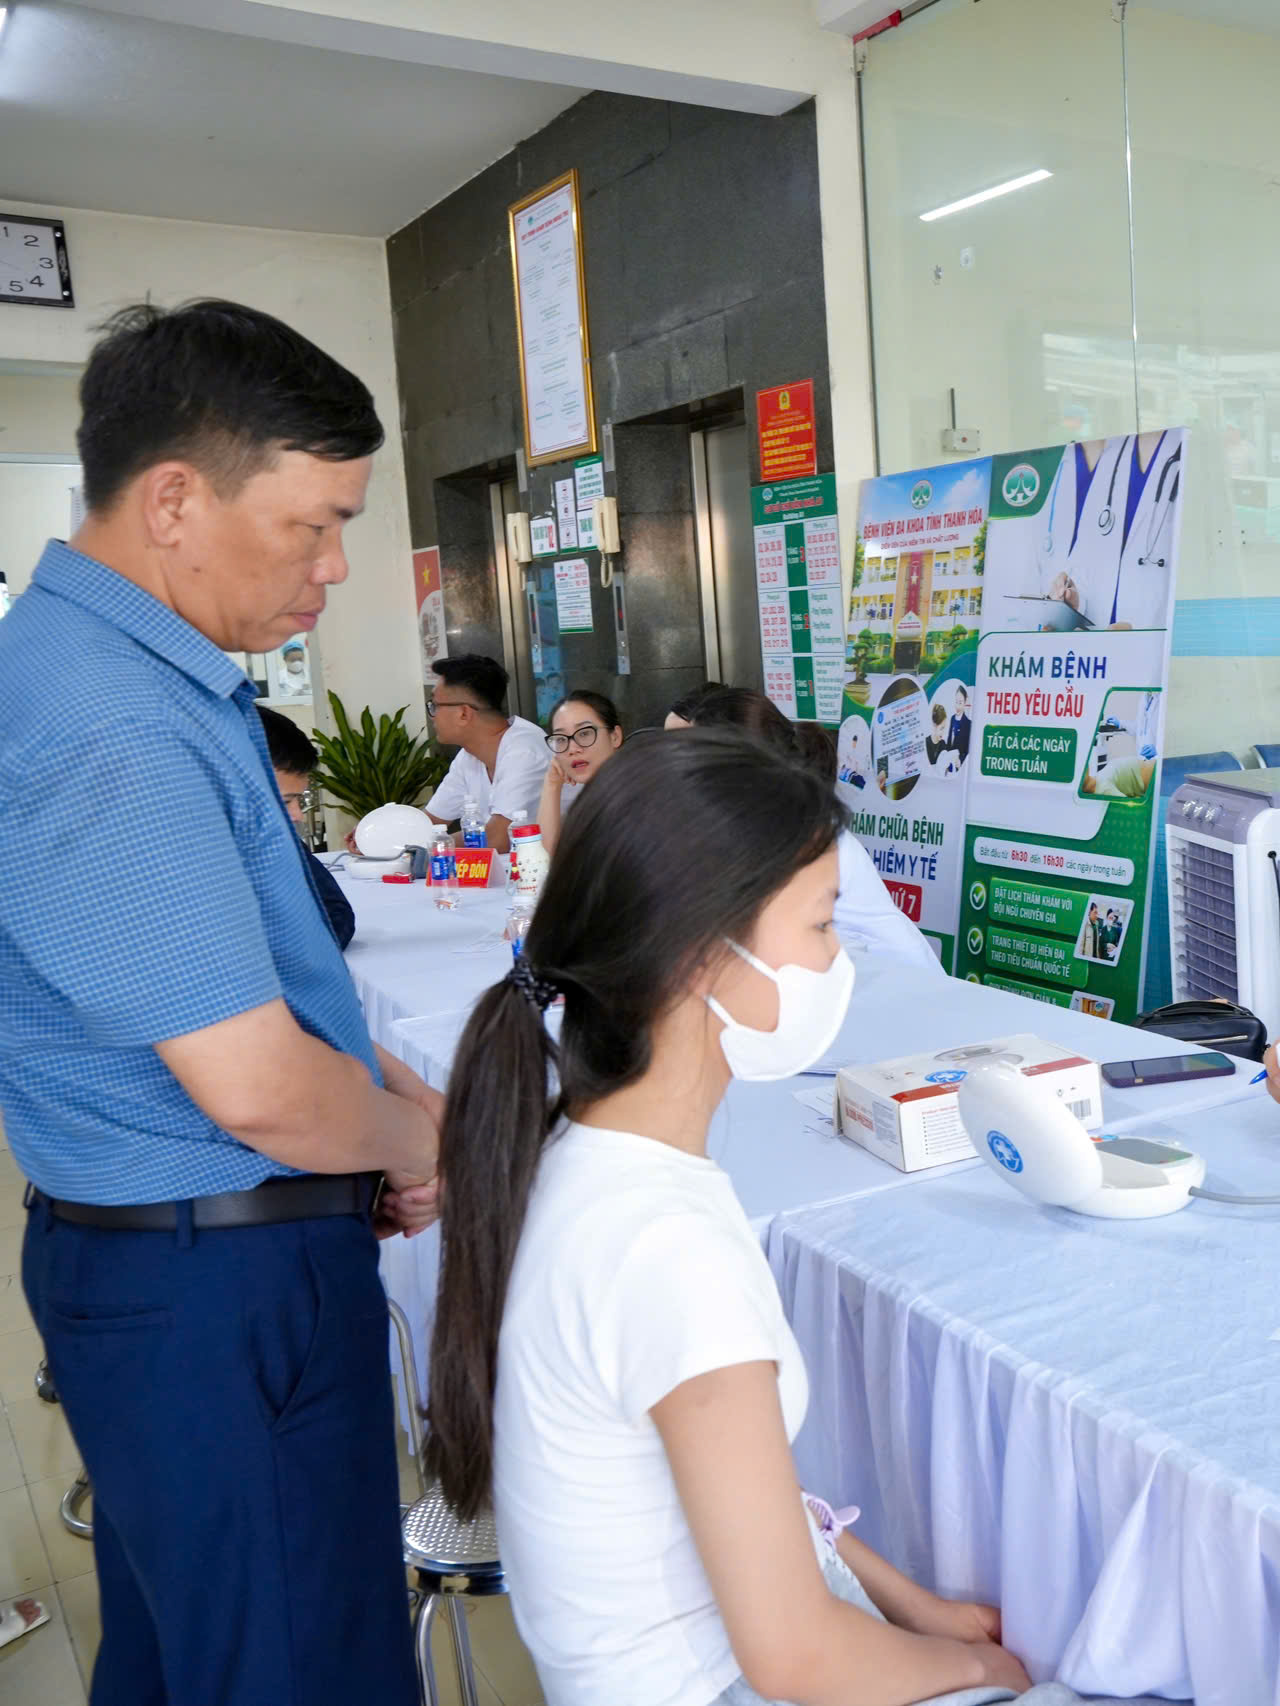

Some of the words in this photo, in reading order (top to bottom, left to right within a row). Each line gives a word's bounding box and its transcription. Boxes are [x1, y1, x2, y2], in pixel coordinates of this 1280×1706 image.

[3, 226, 9, 237] 1
[23, 234, 40, 247] 2
[39, 257, 54, 269] 3
[9, 280, 24, 292] 5
[30, 275, 44, 287] 4
[863, 522, 879, 539] BỆNH
[881, 520, 895, 539] VIỆN
[896, 520, 905, 535] ĐA
[907, 517, 924, 533] KHOA
[926, 512, 942, 530] TỈNH
[943, 511, 967, 528] THANH
[988, 650, 1044, 678] KHÁM
[1051, 650, 1107, 684] BỆNH
[987, 691, 1021, 715] THEO
[1025, 687, 1051, 716] YÊU
[1054, 685, 1084, 718] CẦU
[987, 731, 1004, 748] TẤT
[1005, 732, 1019, 750] CẢ
[1020, 734, 1041, 752] CÁC
[1043, 735, 1071, 753] NGÀY
[985, 756, 1019, 772] TRONG
[1021, 755, 1048, 774] TUẦN
[851, 808, 876, 836] HÁM
[879, 812, 909, 841] CHỮA
[912, 816, 944, 849] BỆNH
[469, 859, 488, 878] ĐÓN
[873, 844, 906, 875] HIỂM
[909, 855, 918, 877] Y
[920, 851, 938, 880] TẾ
[980, 846, 989, 856] Bắt
[1011, 850, 1028, 862] 6h30
[1030, 854, 1041, 864] đến
[1043, 855, 1064, 868] 16h30
[1066, 860, 1077, 870] các
[1077, 861, 1092, 873] ngày
[1093, 864, 1110, 877] trong
[1111, 865, 1126, 877] tuần
[908, 894, 917, 914] 7
[994, 887, 1007, 901] ĐẶT
[1008, 889, 1022, 903] LỊCH
[1042, 893, 1061, 908] KHÁM
[1061, 897, 1073, 911] VỚI
[993, 901, 1005, 917] ĐỘI
[1005, 903, 1019, 916] NGŨ
[1020, 907, 1044, 922] CHUYÊN
[1045, 912, 1057, 924] GIA
[991, 935, 1012, 949] TRANG
[1012, 938, 1029, 953] THIẾT
[1030, 942, 1037, 956] BỊ
[1037, 943, 1053, 960] HIỆN
[1053, 949, 1065, 962] ĐẠI
[991, 950, 1007, 962] THEO
[1007, 952, 1021, 966] TIÊU
[1021, 954, 1043, 969] CHUẨN
[1043, 957, 1061, 975] QUỐC
[1061, 963, 1071, 978] TẾ
